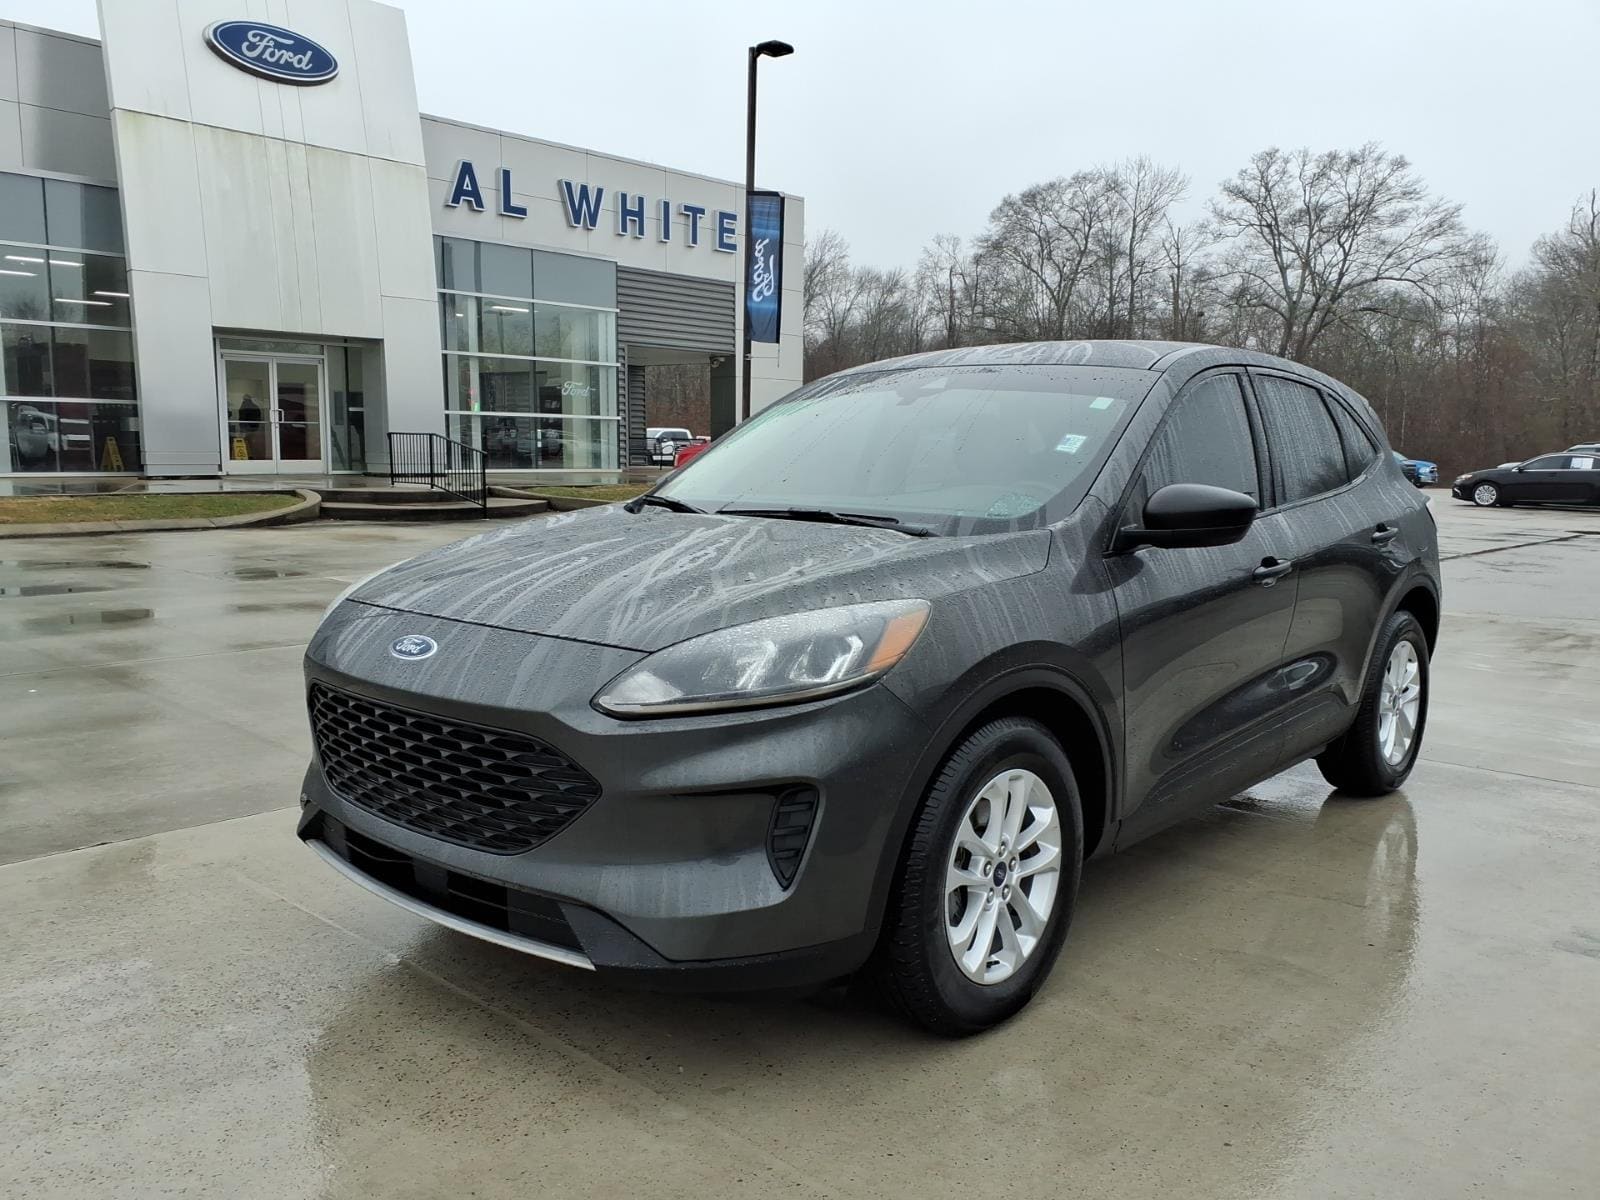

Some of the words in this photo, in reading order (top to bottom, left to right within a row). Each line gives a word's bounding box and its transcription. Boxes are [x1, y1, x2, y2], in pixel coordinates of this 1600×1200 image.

[241, 30, 313, 70] Ford
[447, 159, 528, 218] AL
[559, 178, 738, 253] WHITE
[752, 238, 774, 302] Ford
[561, 381, 590, 397] Ford
[396, 638, 425, 654] Ford
